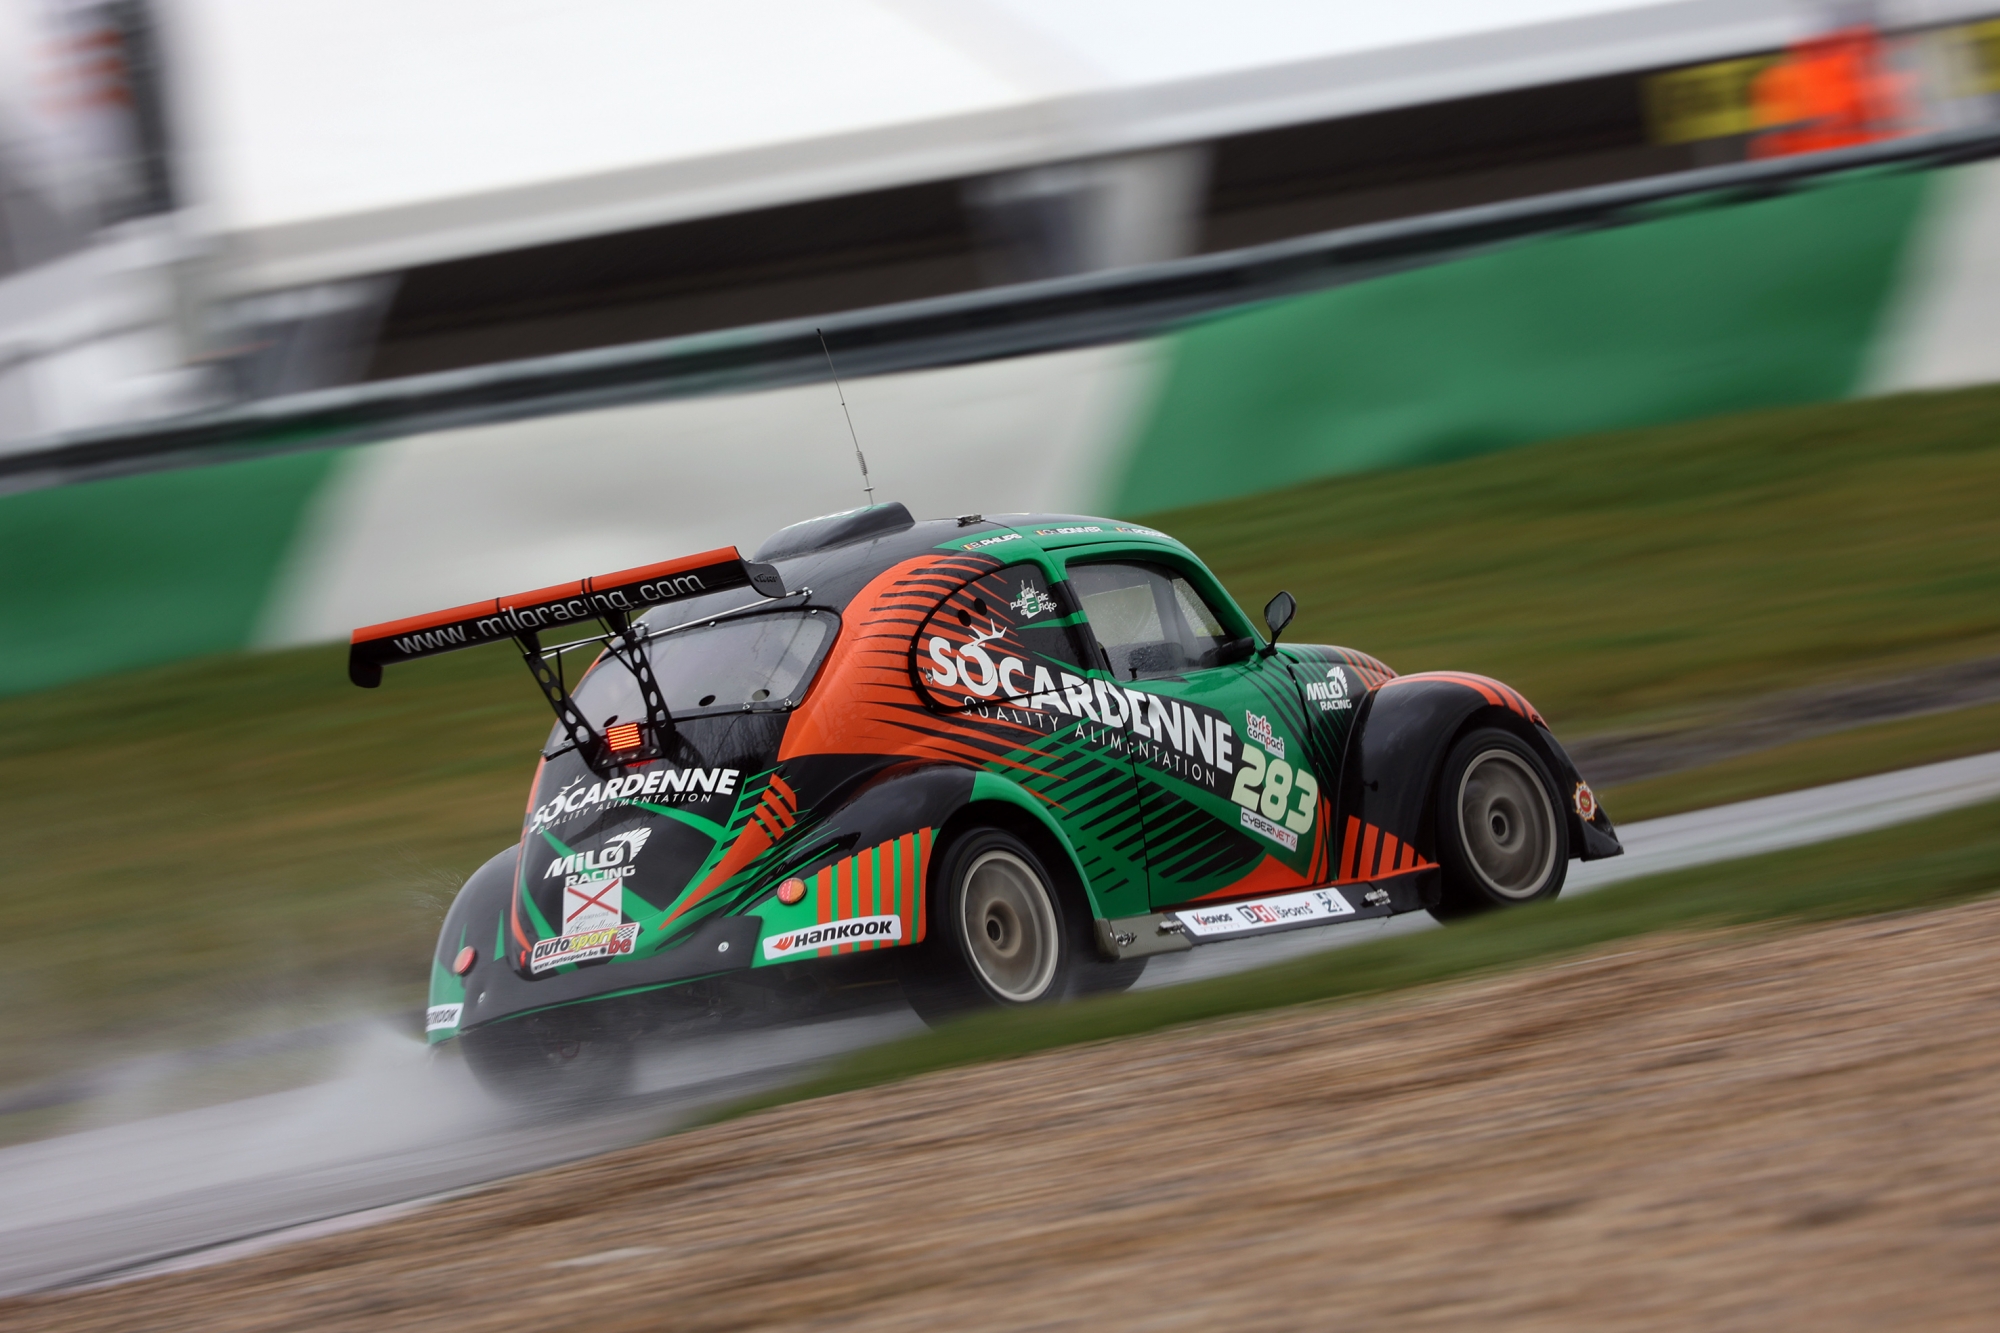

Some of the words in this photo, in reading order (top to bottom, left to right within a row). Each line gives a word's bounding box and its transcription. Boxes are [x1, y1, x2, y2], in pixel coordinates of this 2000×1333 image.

[928, 636, 1233, 775] SOCARDENNE
[1247, 712, 1271, 735] torfs
[1320, 698, 1352, 712] RACING
[1075, 722, 1216, 788] ALIMENTATION
[1248, 727, 1284, 752] compact
[529, 767, 741, 834] SOCARDENNE
[1230, 743, 1319, 835] 283
[536, 806, 590, 835] QUALITY
[596, 793, 712, 813] ALIMENTATION
[565, 864, 636, 887] RACING
[535, 927, 619, 960] autosport
